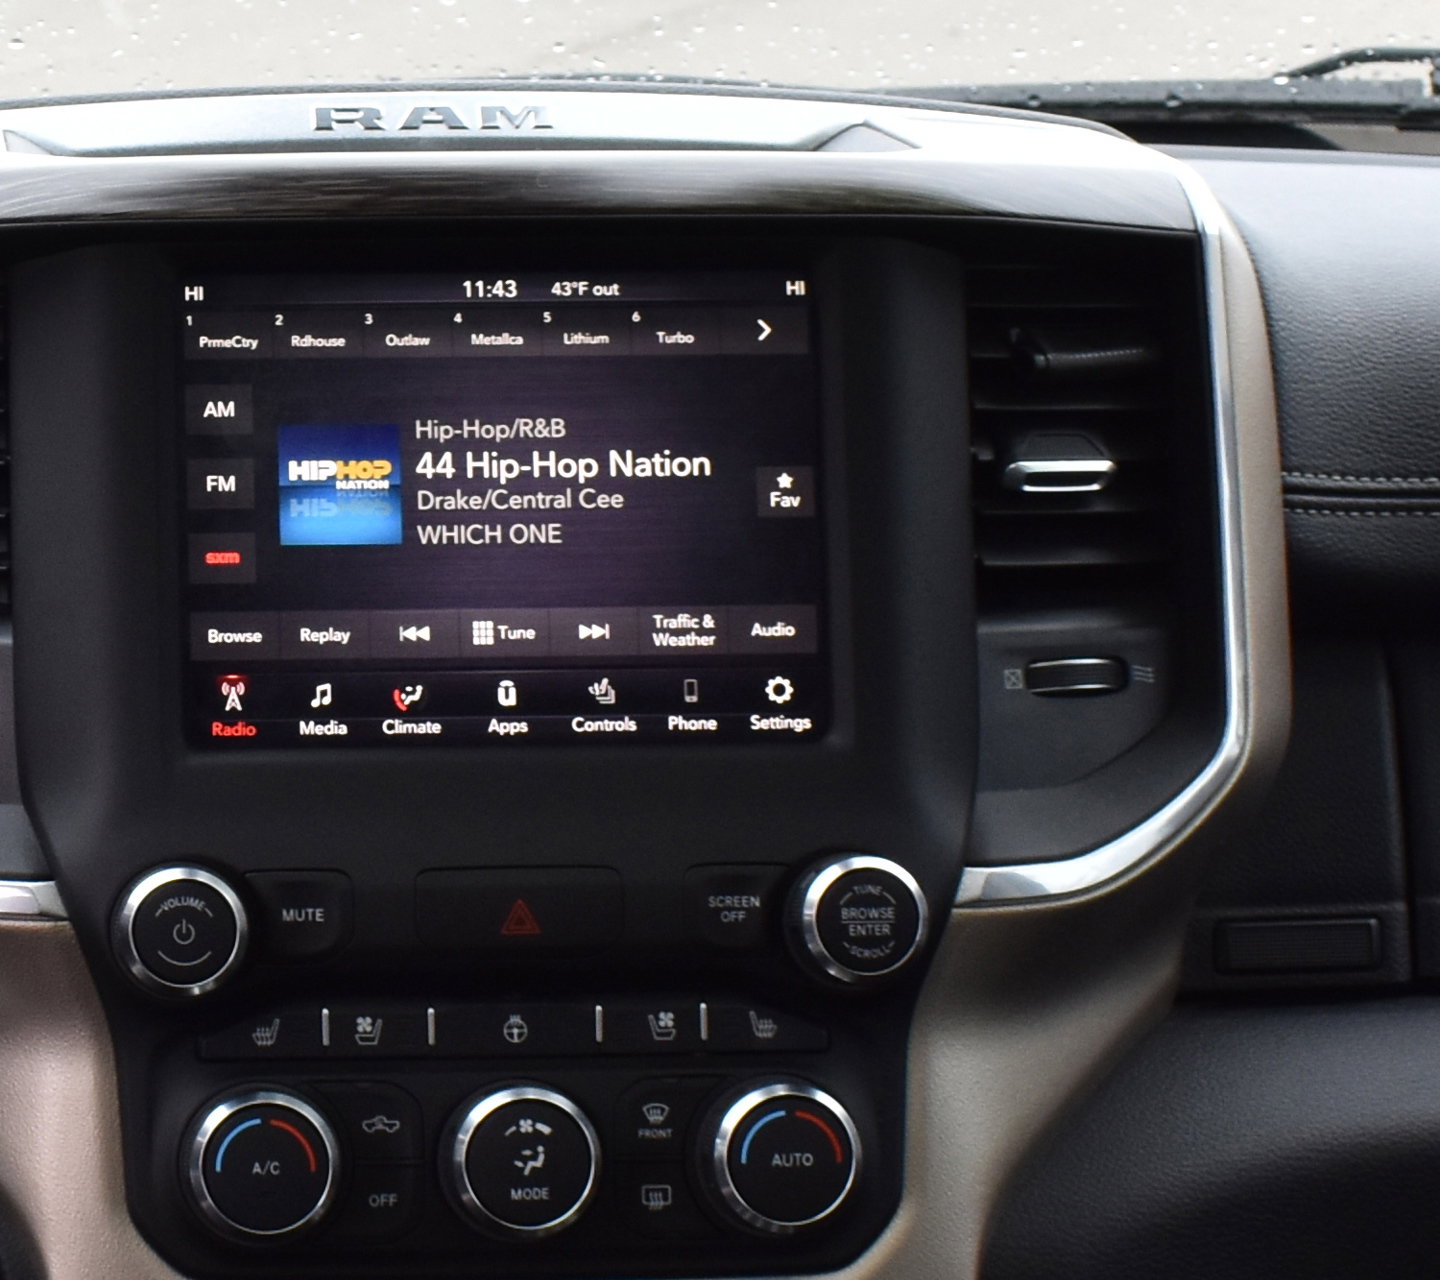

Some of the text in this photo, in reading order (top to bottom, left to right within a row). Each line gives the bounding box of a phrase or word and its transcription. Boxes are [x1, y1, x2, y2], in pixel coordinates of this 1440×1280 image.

[314, 106, 554, 131] RAM
[184, 286, 205, 301] HI
[462, 279, 518, 298] 11:43
[551, 281, 620, 297] 43°F out
[786, 280, 806, 296] HI
[186, 314, 193, 327] 1
[274, 313, 284, 326] 2
[364, 312, 374, 325] 3
[453, 312, 463, 324] 4
[542, 311, 552, 323] 5
[631, 310, 641, 323] 6
[199, 335, 259, 350] PrmeCtry
[290, 335, 346, 348] Rdhouse
[385, 333, 431, 347] Outlaw
[563, 332, 610, 345] Lithium
[656, 331, 695, 345] Turbo
[203, 402, 236, 419] AM
[414, 418, 567, 441] Hip-Hop/R&B
[415, 451, 712, 484] 44 Hip-Hop Nation
[206, 475, 236, 493] FM
[335, 479, 390, 490] NATION
[416, 489, 624, 512] Drake/Central Cee
[769, 490, 801, 508] Fav
[416, 523, 562, 545] WHICH ONE
[206, 552, 240, 565] sxm
[653, 614, 715, 631] Traffic &
[751, 622, 795, 638] Audio
[207, 628, 262, 644] Browse
[300, 627, 351, 644] Replay
[497, 624, 536, 641] Tune
[652, 631, 716, 647] Weather
[212, 721, 256, 738] Radio
[299, 720, 348, 736] Media
[382, 718, 442, 736] Climate
[488, 718, 529, 737] Apps
[571, 716, 637, 734] Controls
[667, 715, 717, 732] Phone
[750, 714, 812, 733] Settings
[853, 885, 883, 897] TUNE
[162, 896, 206, 912] VOLUME
[708, 895, 760, 908] SCREEN
[282, 909, 325, 922] MUTE
[721, 911, 746, 923] OFF
[841, 907, 896, 920] BROWSE
[848, 924, 891, 937] ENTER
[849, 943, 892, 959] SCROLL
[638, 1128, 672, 1139] FRONT
[252, 1161, 280, 1175] A/C
[771, 1153, 814, 1168] AUTO
[369, 1194, 398, 1207] OFF
[510, 1188, 550, 1201] MODE
